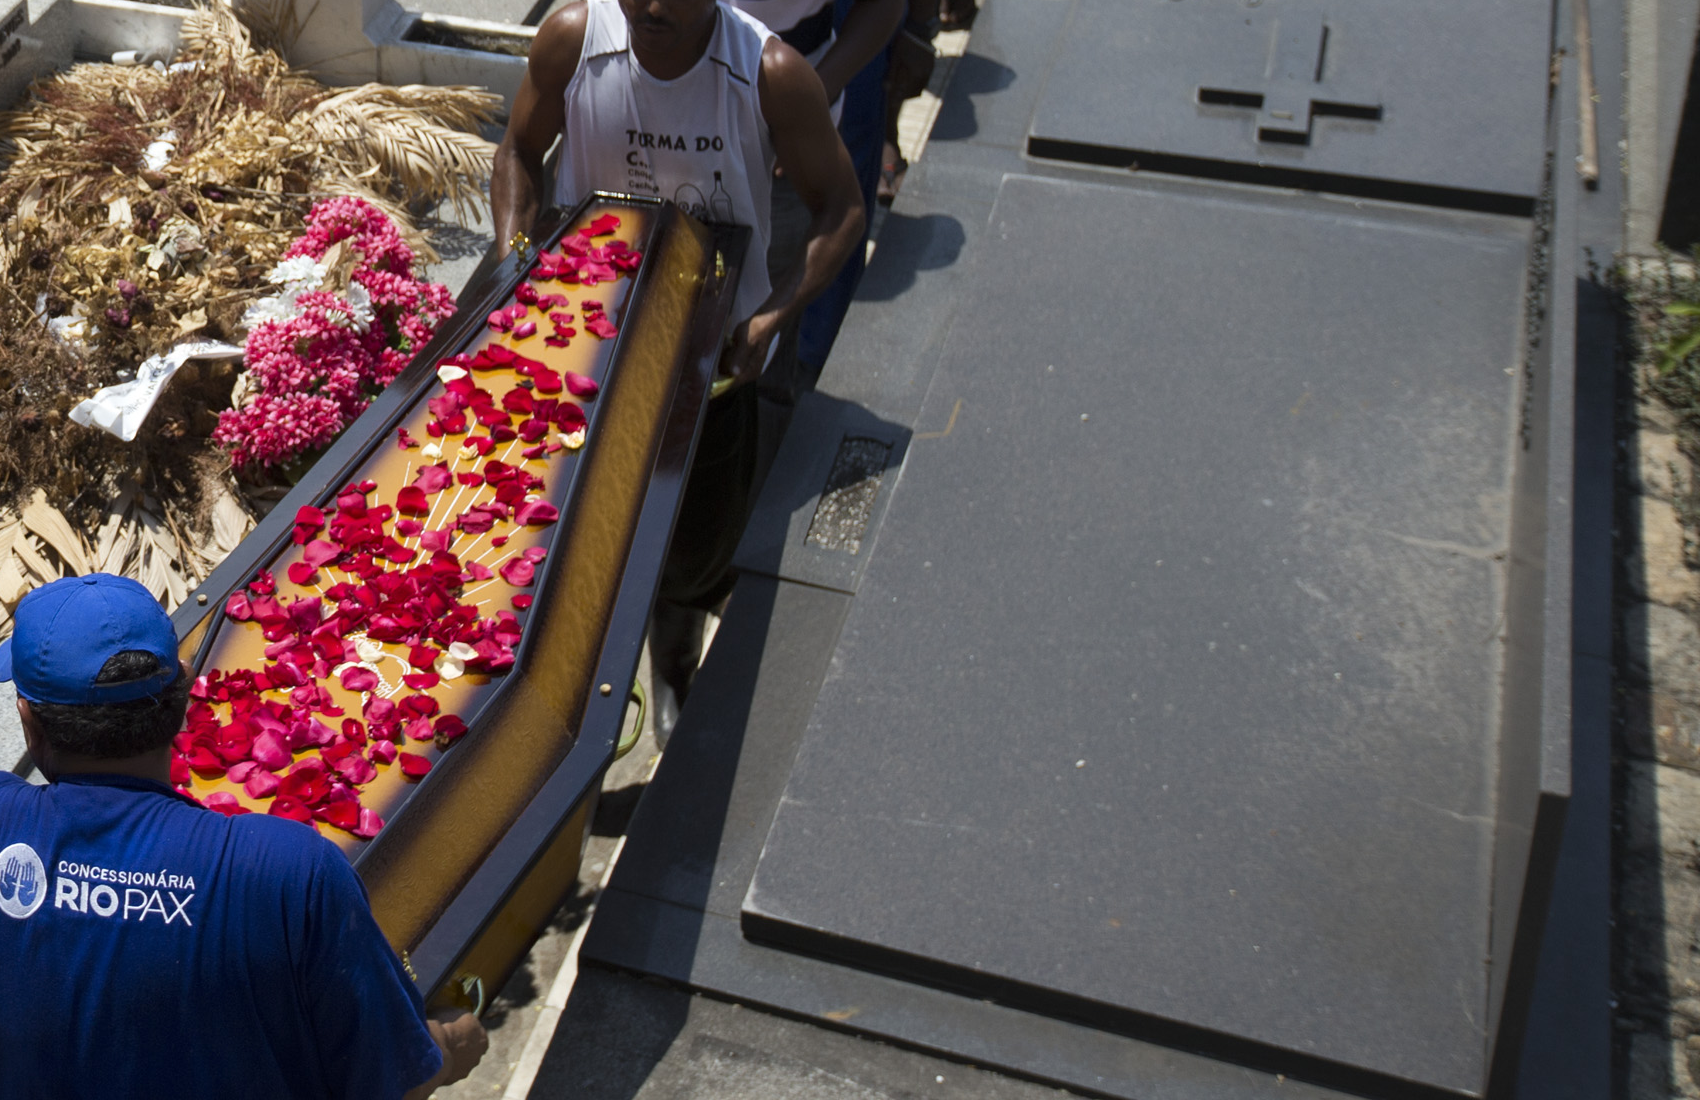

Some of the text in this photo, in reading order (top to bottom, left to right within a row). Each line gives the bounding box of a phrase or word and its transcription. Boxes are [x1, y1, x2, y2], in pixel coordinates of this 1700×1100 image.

[626, 129, 725, 152] TURMA DO
[58, 860, 196, 890] CONCESSIONÁRIA
